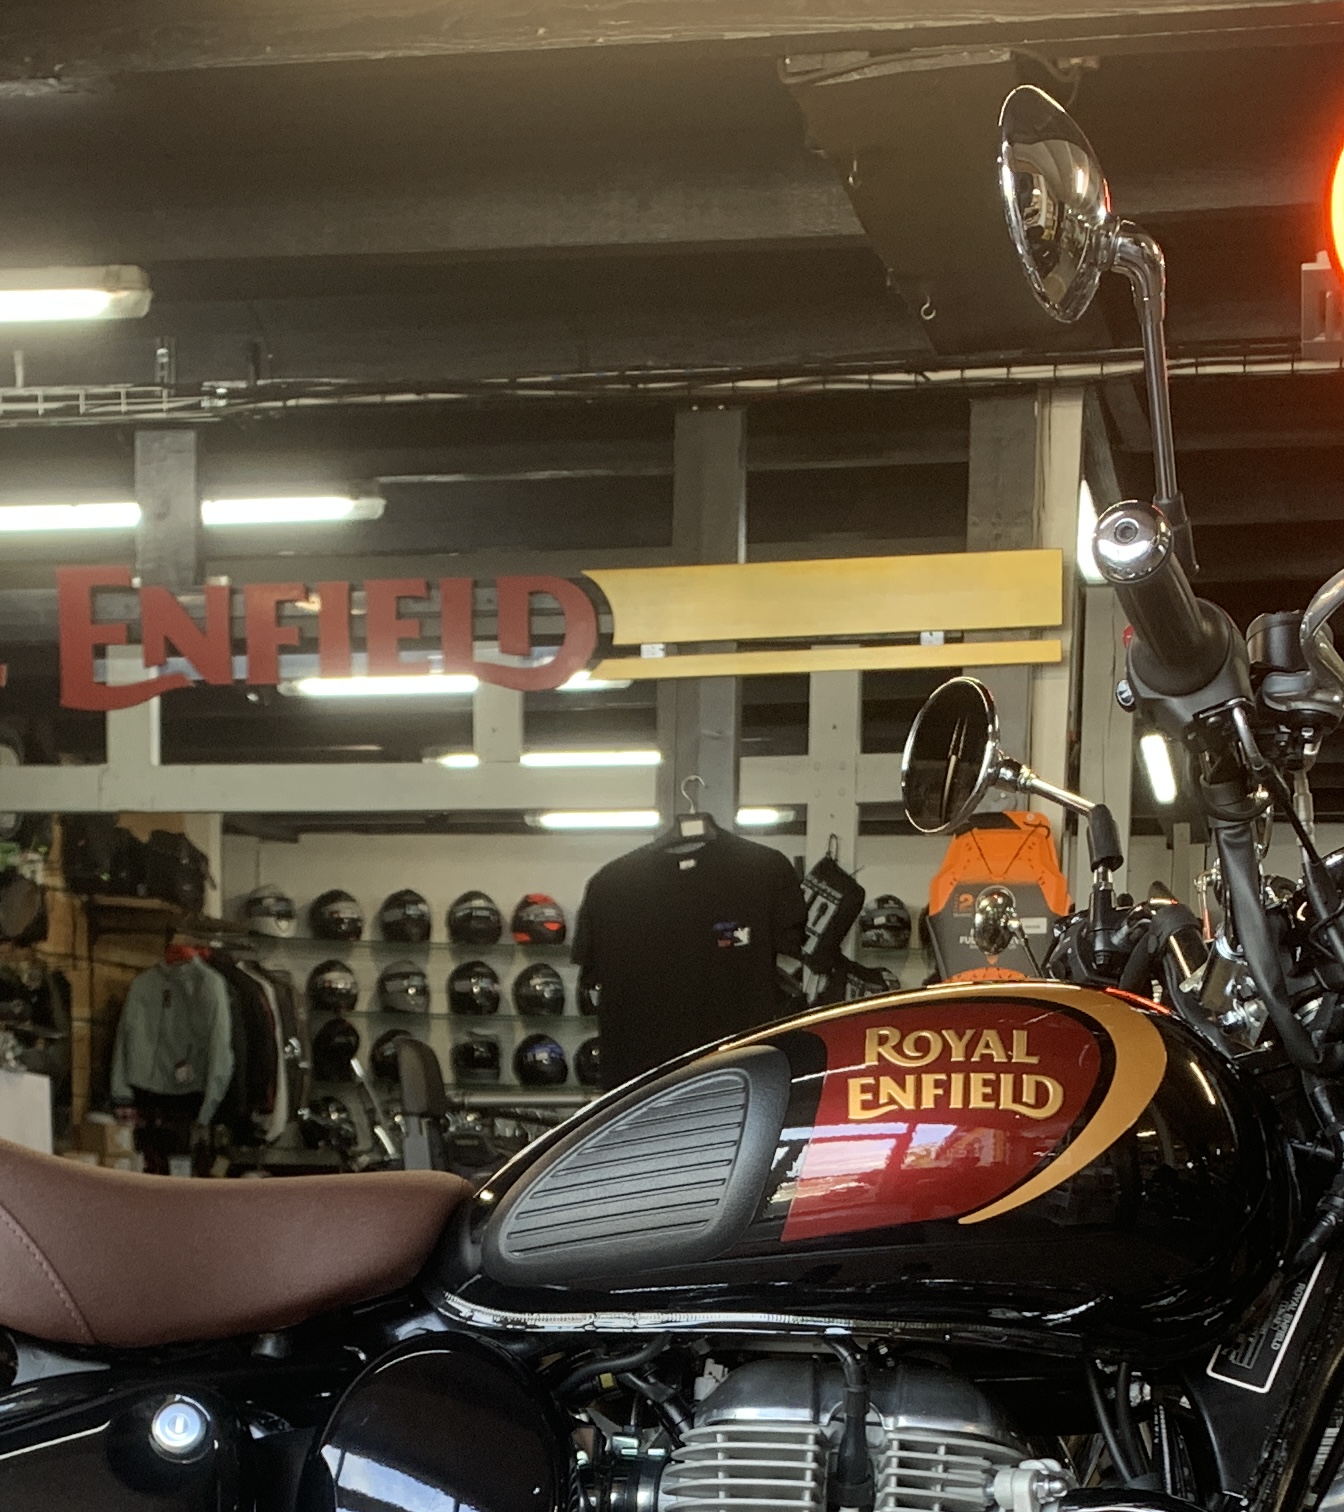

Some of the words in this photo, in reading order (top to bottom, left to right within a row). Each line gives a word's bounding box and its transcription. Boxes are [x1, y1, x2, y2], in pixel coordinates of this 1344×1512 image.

[56, 565, 601, 711] ENFIELD
[863, 1025, 1041, 1068] ROYAL
[846, 1070, 1065, 1122] ENFIELD
